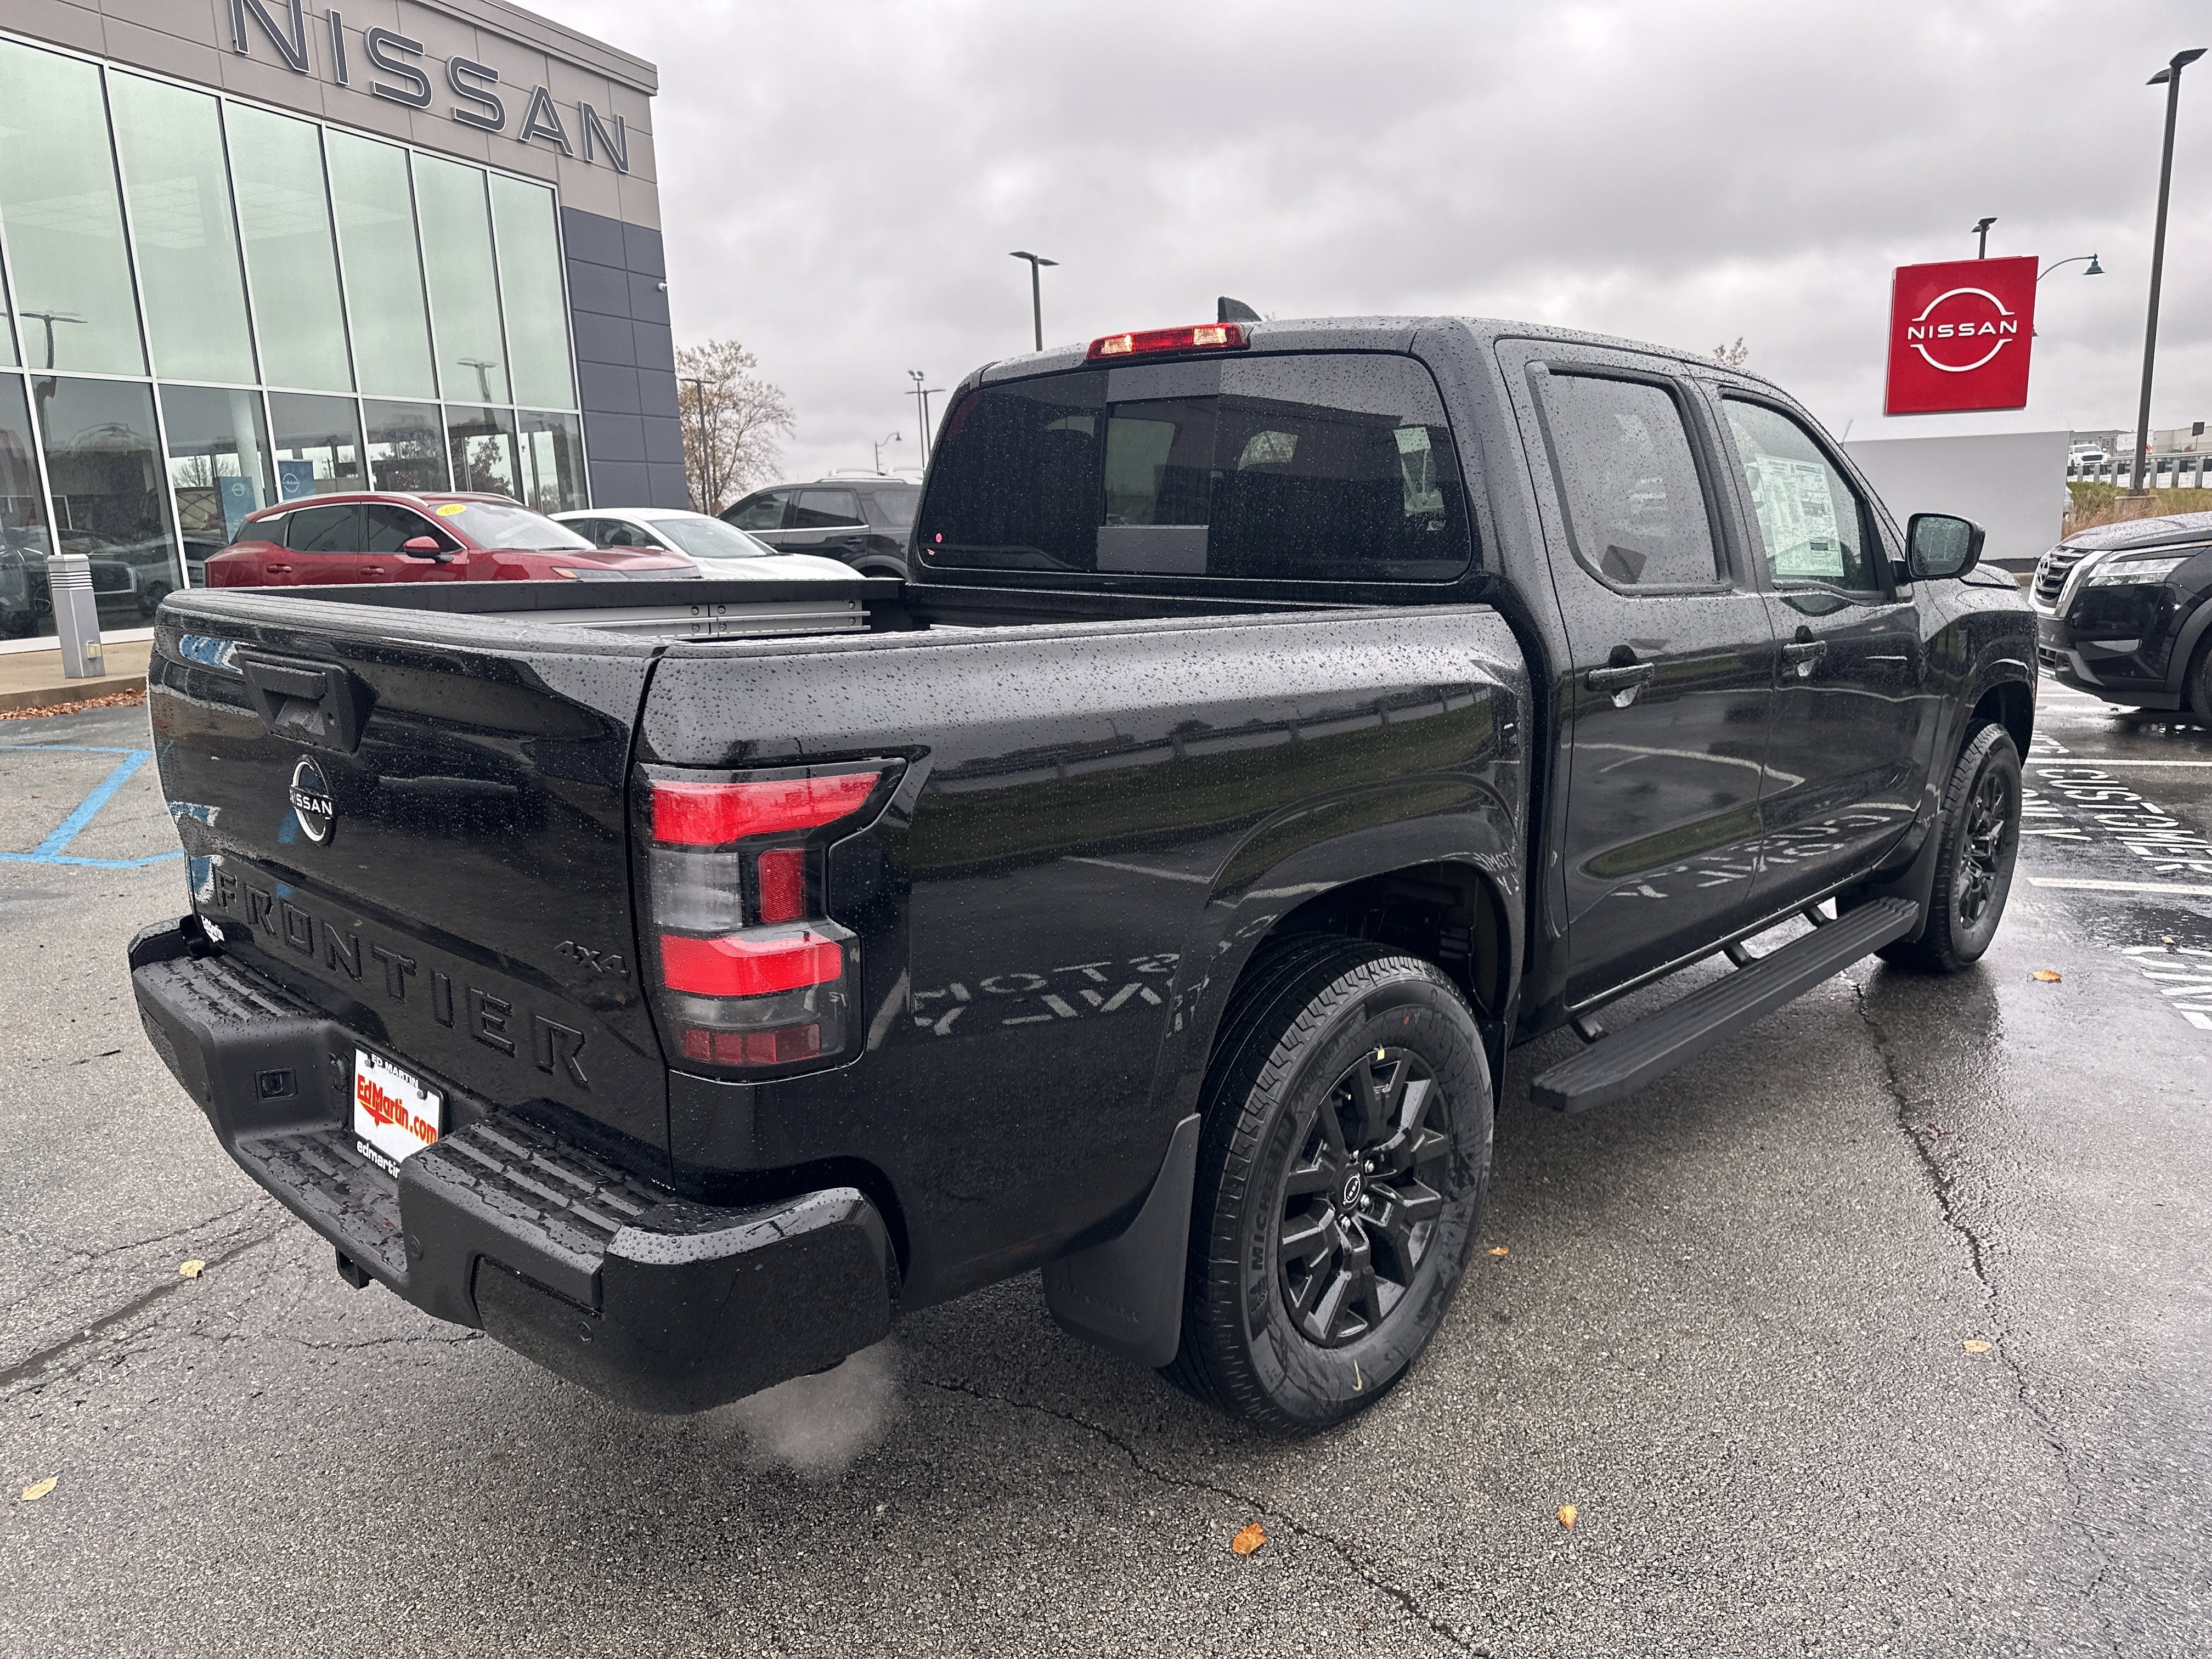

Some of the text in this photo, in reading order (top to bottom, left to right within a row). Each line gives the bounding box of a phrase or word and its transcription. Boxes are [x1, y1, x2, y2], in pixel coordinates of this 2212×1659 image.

[229, 0, 630, 174] NISSAN
[1908, 319, 2017, 340] NISSAN
[289, 787, 333, 816] NISSAN
[212, 865, 591, 1091] FRONTIER
[371, 1053, 419, 1089] ED MARTIN
[357, 1074, 437, 1145] EdMartin.com
